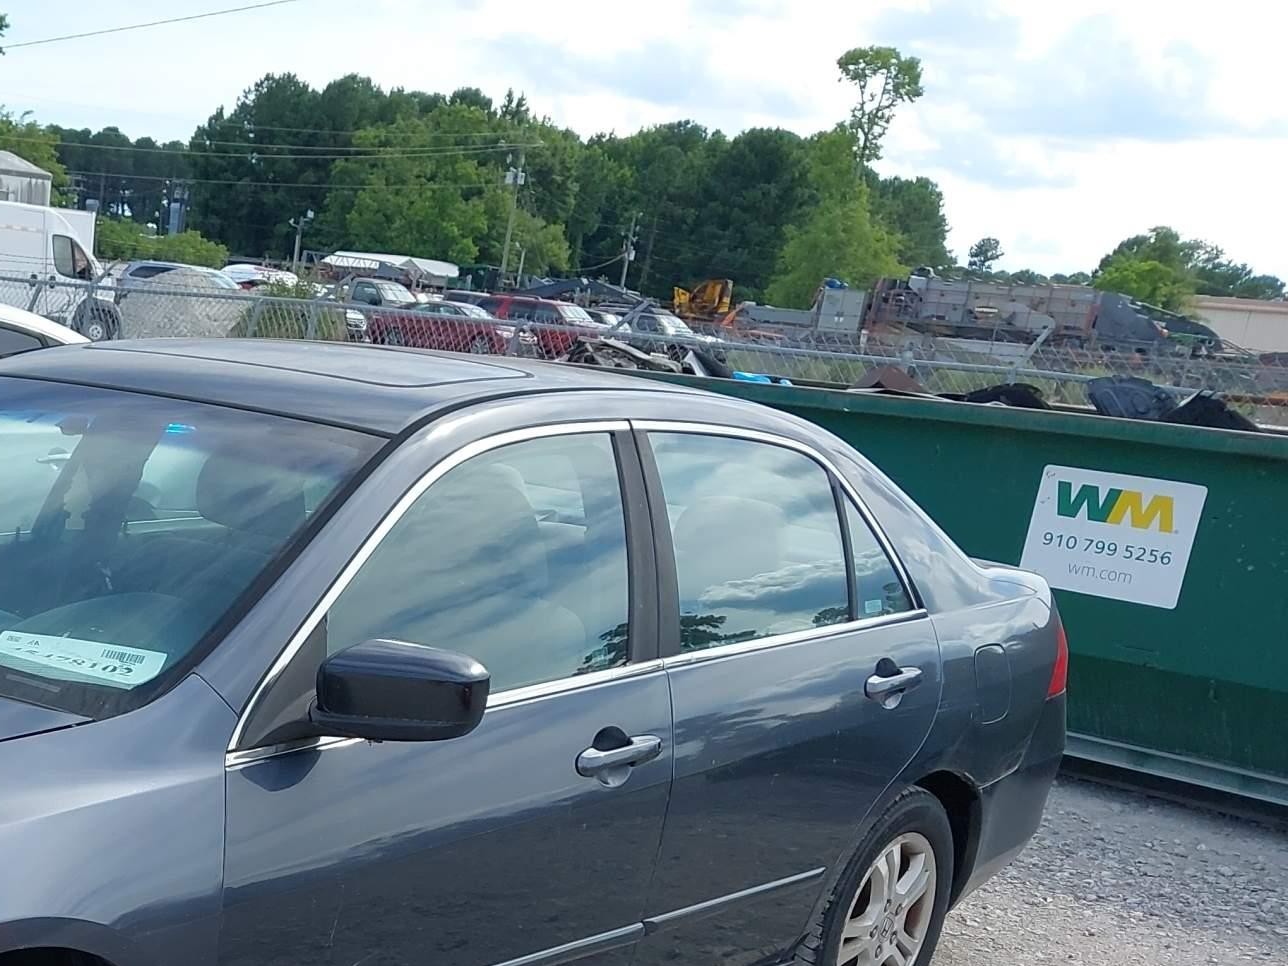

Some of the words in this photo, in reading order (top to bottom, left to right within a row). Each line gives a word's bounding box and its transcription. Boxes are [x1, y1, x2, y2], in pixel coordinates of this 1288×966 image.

[1057, 480, 1174, 534] WM
[1042, 531, 1078, 550] 910
[1083, 538, 1118, 556] 799
[1122, 545, 1173, 566] 5256
[1067, 563, 1133, 585] wm.com
